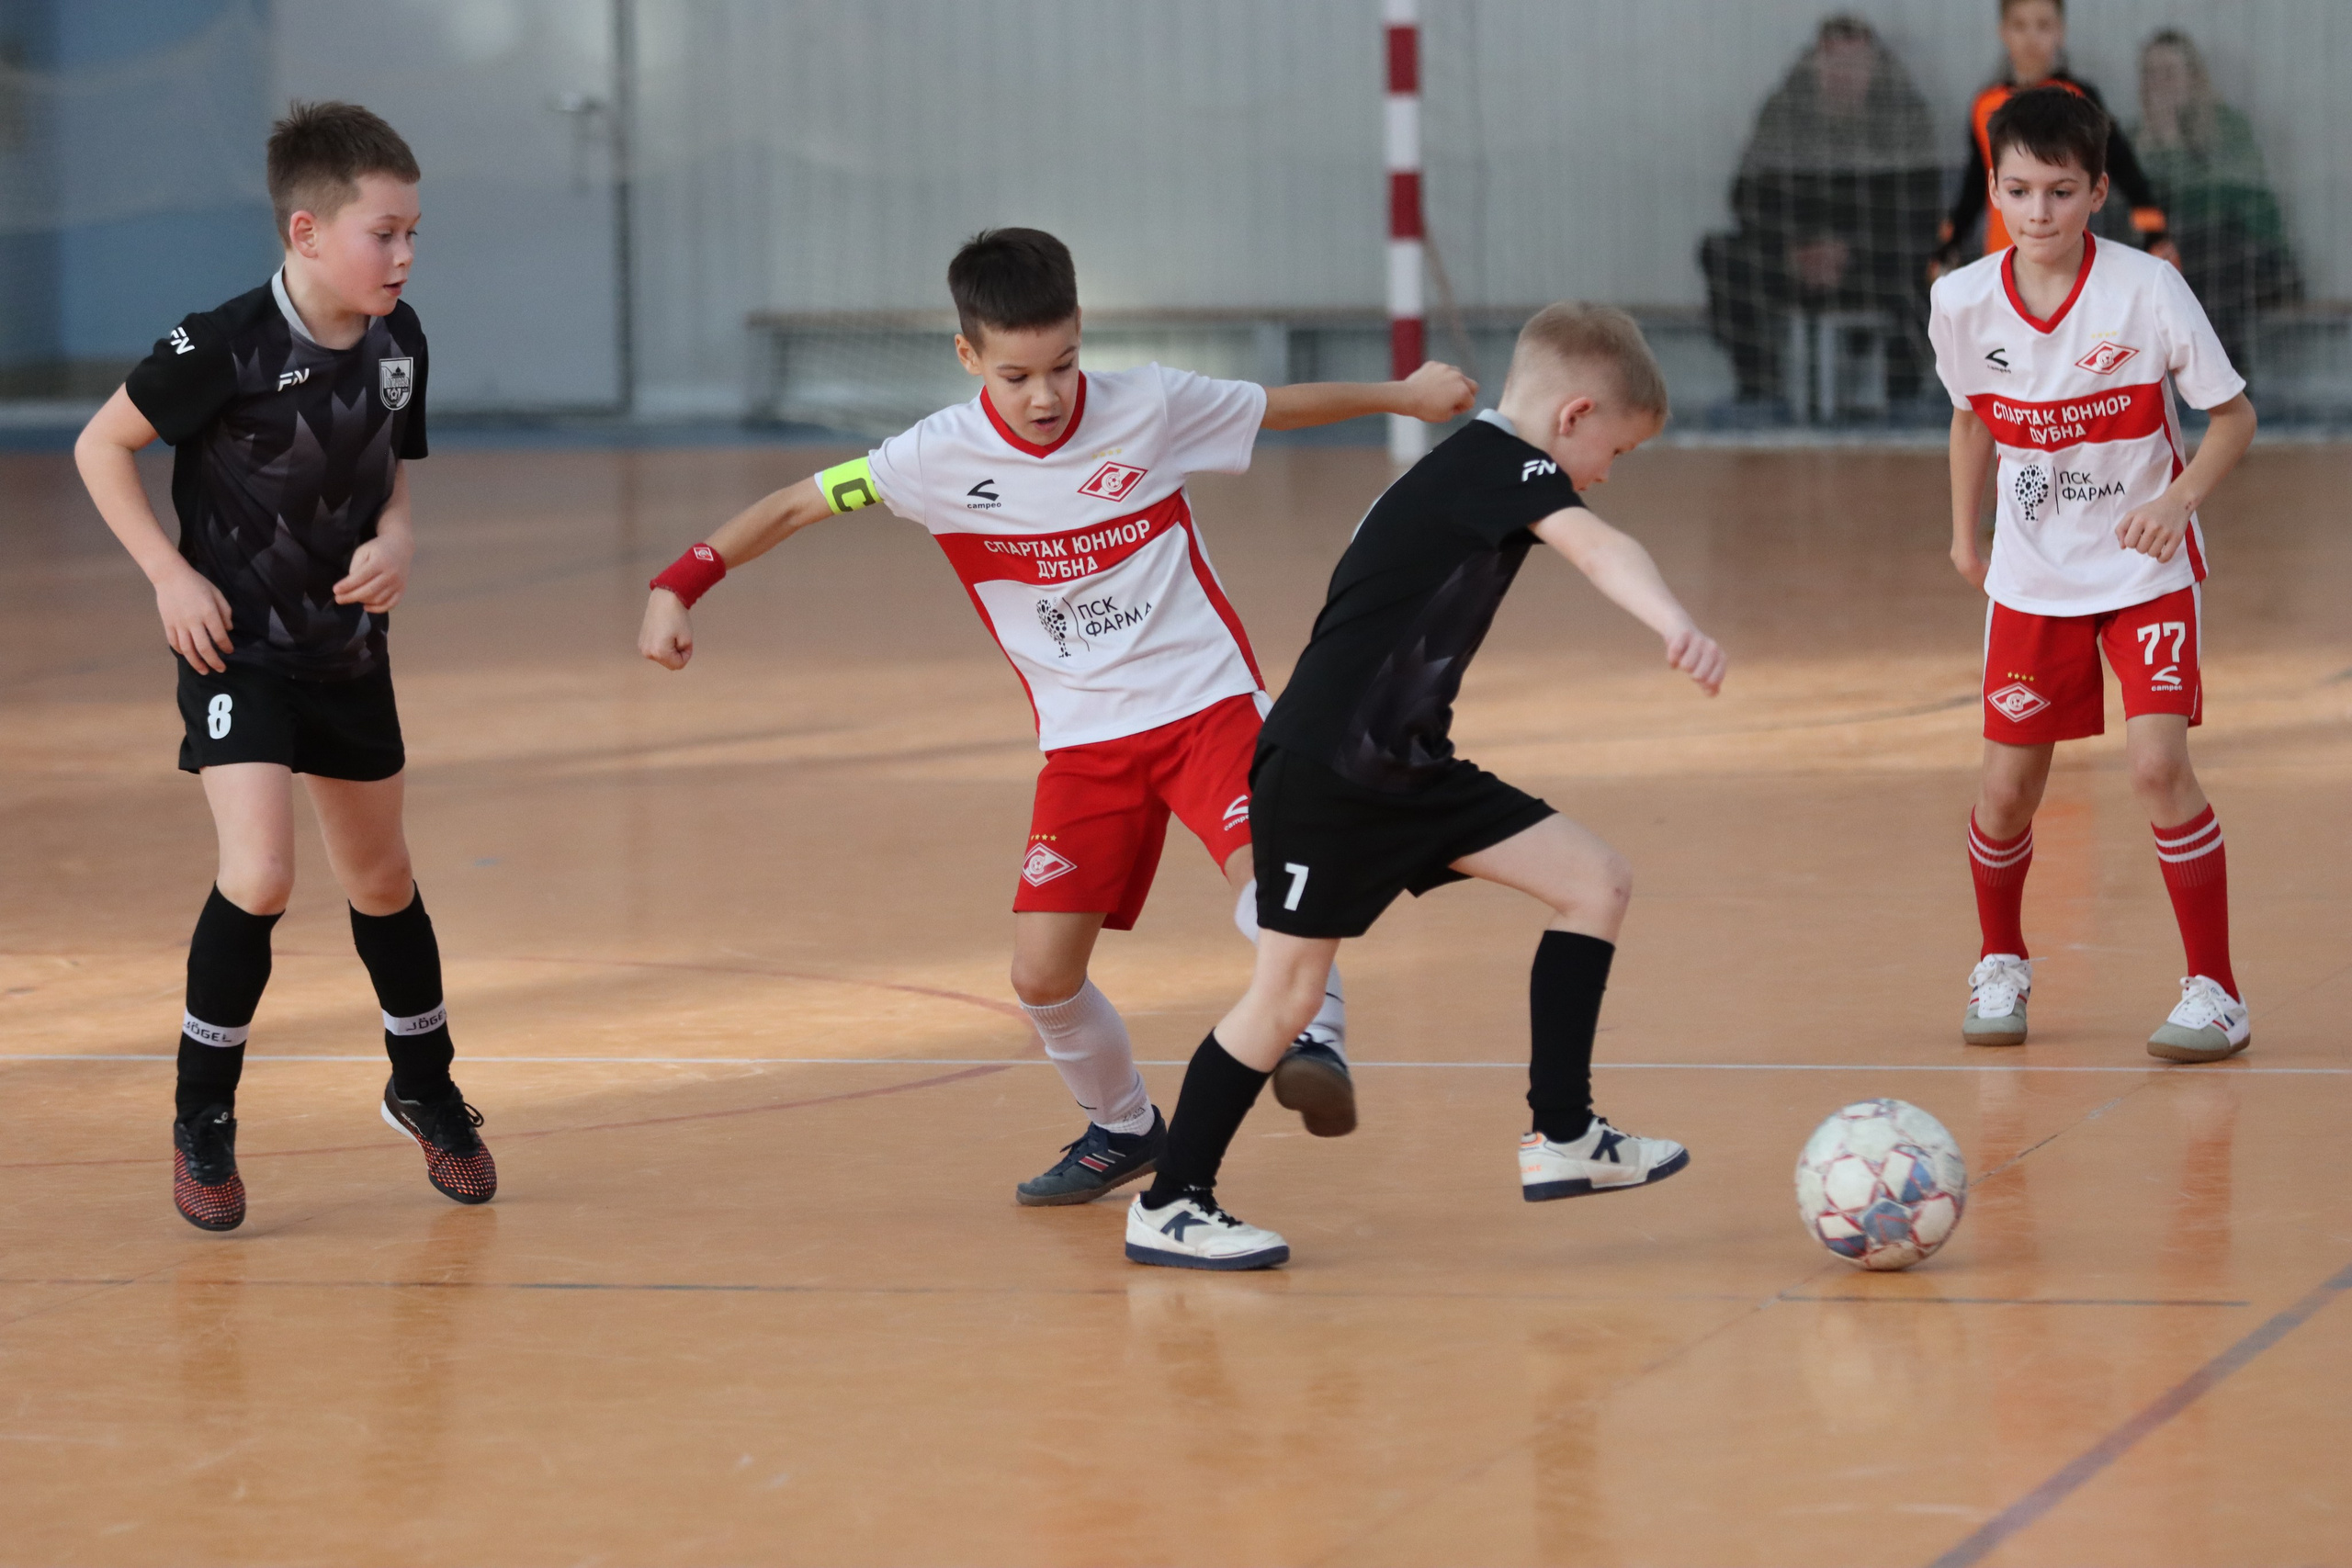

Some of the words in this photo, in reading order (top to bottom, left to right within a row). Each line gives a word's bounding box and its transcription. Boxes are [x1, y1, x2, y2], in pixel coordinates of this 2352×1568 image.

[170, 326, 196, 355] FN
[277, 367, 310, 392] FN
[1993, 400, 2057, 426] СПАРТАК
[2061, 395, 2132, 423] ЮНИОР
[2029, 423, 2086, 445] ДУБНА
[1521, 459, 1557, 482] FN
[2059, 470, 2093, 485] ПСК
[2062, 480, 2125, 502] ФАРМА
[967, 502, 1001, 510] campeo
[983, 538, 1068, 558] СПАРТАК
[1072, 519, 1150, 555] ЮНИОР
[1036, 556, 1099, 579] ДУБНА
[1077, 596, 1118, 620] ПСК
[2136, 621, 2186, 665] 77
[207, 694, 233, 739] 8
[1224, 814, 1250, 831] campe
[1283, 862, 1309, 911] 7
[405, 1008, 447, 1032] JÖGE
